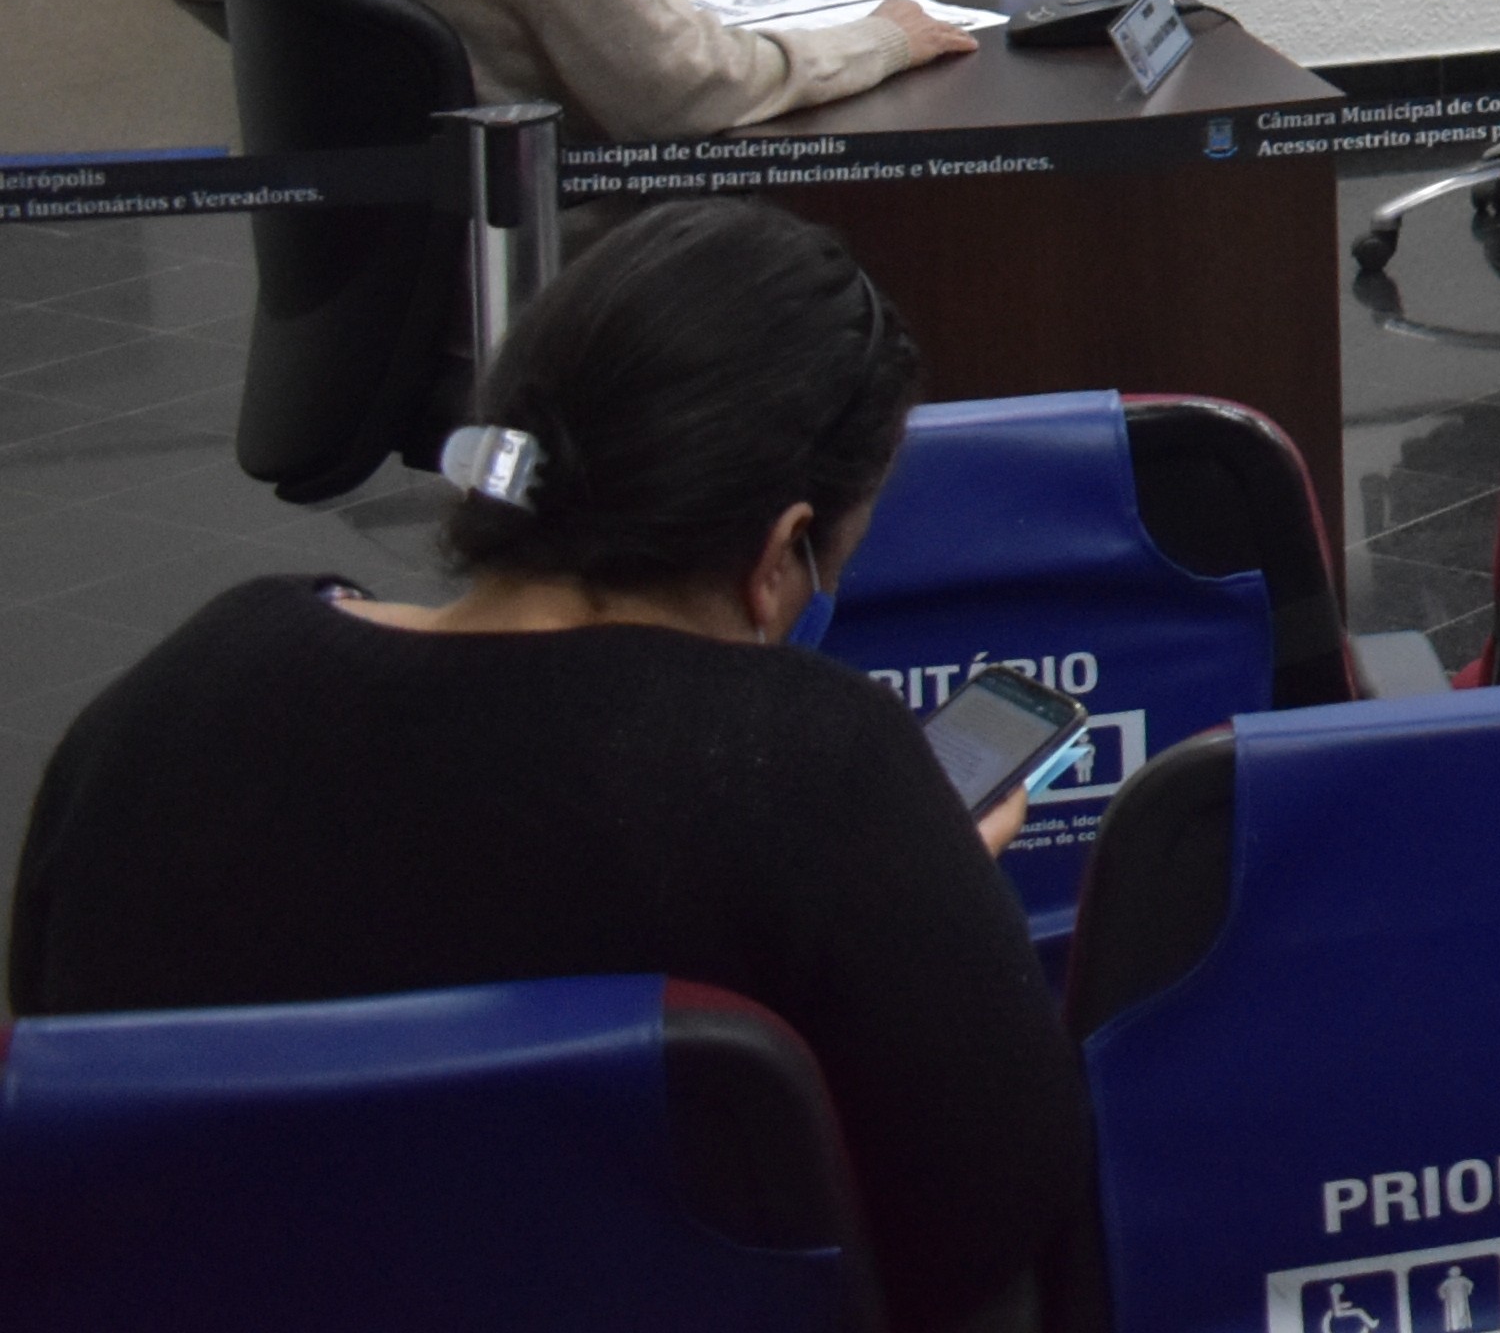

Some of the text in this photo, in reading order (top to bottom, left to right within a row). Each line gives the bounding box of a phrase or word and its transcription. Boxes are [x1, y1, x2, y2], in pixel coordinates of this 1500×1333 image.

[1257, 111, 1337, 130] Câmara
[1340, 99, 1443, 124] Municipal
[1446, 97, 1472, 115] de
[663, 144, 690, 161] de
[695, 136, 847, 161] Cordeirópolis
[1257, 136, 1328, 157] Acesso
[1333, 128, 1411, 151] restrito
[1415, 124, 1488, 148] apenas
[627, 171, 707, 194] apenas
[711, 168, 762, 190] para
[767, 161, 906, 184] funcionários
[910, 162, 924, 178] e
[928, 154, 1055, 176] Vereadores.
[28, 193, 169, 218] funcionários
[174, 195, 187, 211] e
[191, 186, 324, 209] Vereadores.
[1055, 832, 1074, 845] de
